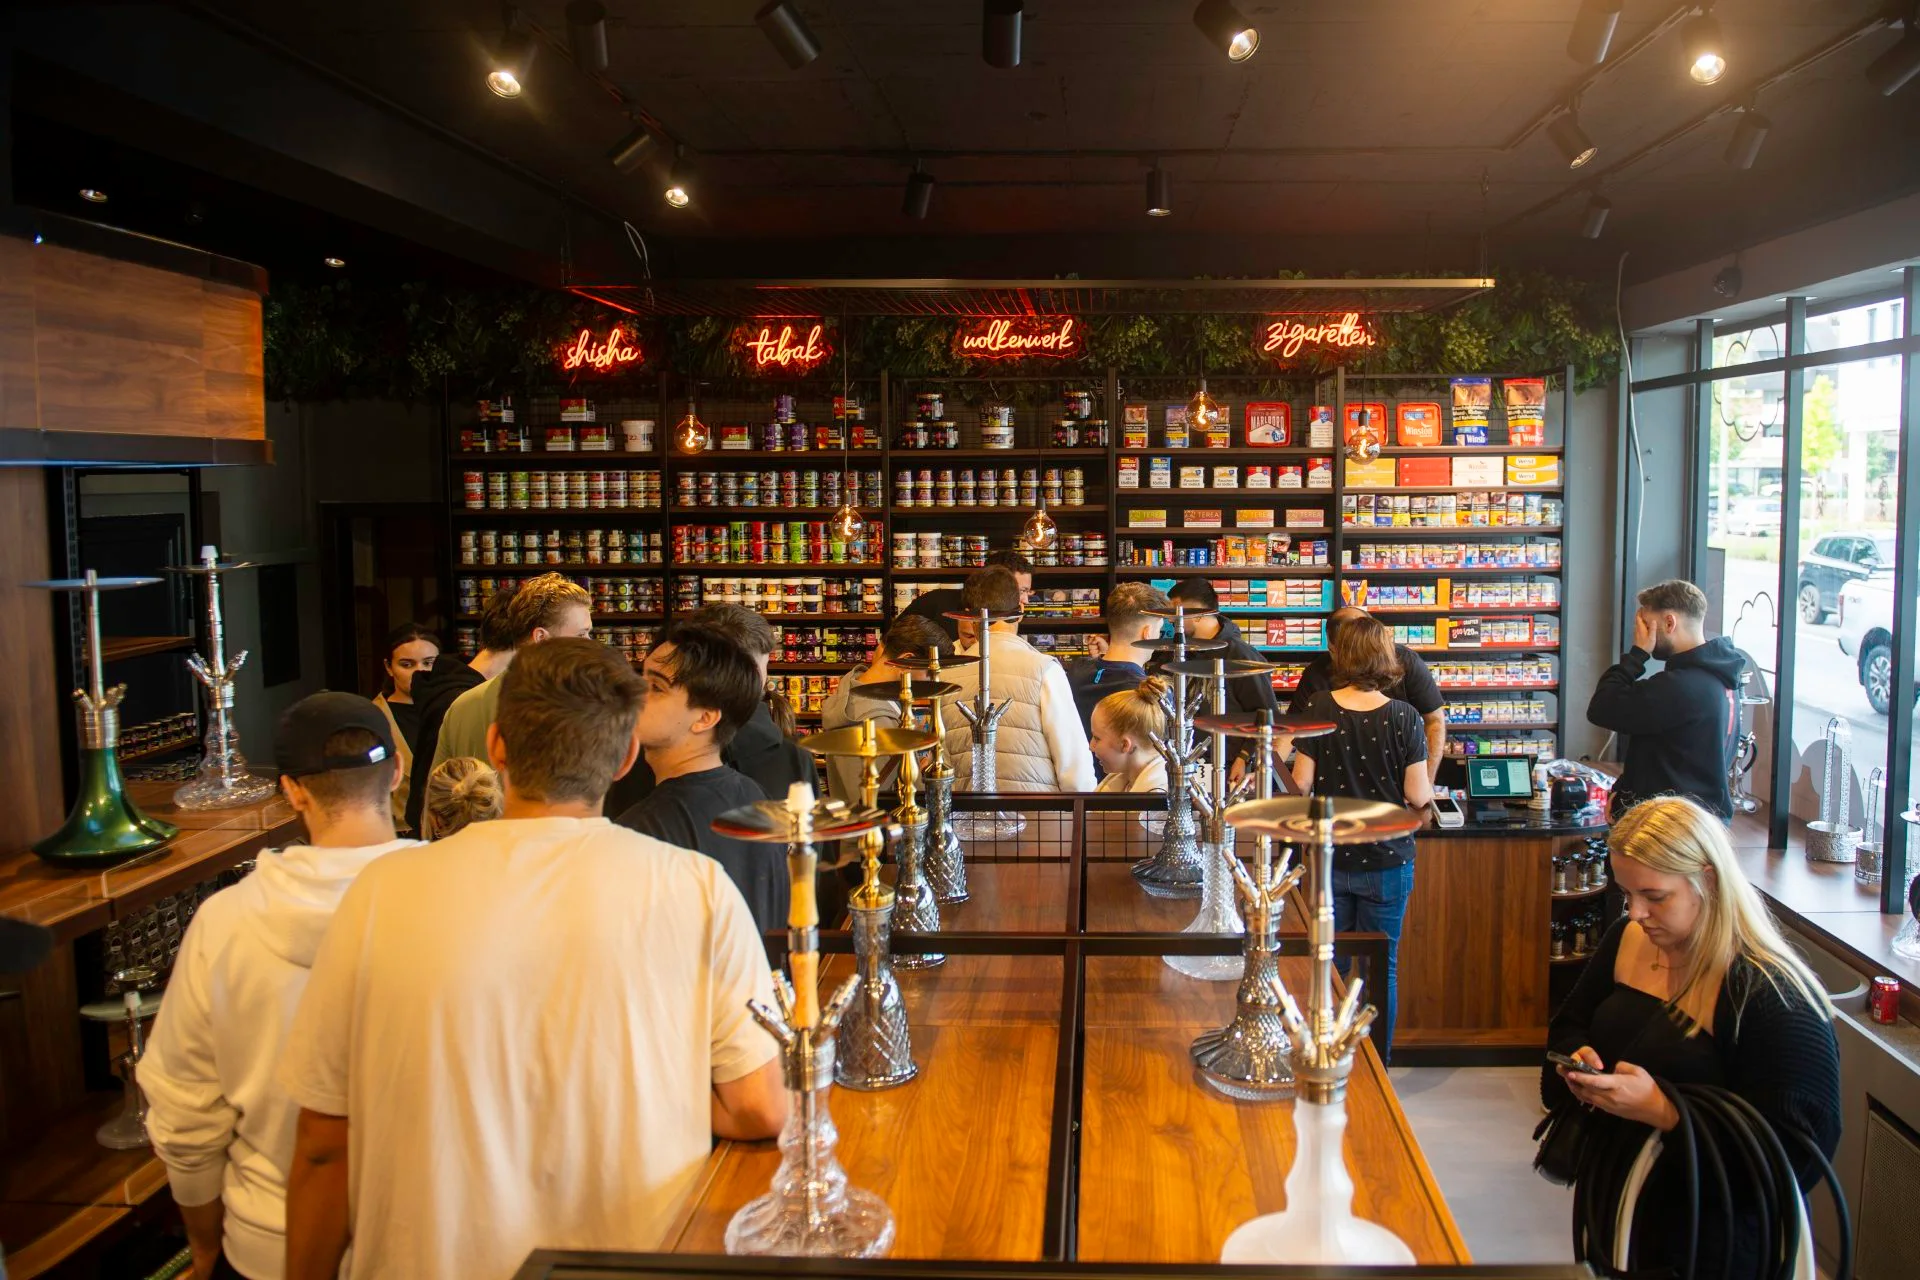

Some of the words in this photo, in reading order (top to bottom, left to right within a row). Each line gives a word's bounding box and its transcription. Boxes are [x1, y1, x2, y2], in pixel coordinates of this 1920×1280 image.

[564, 329, 638, 369] shisha
[747, 325, 824, 365] tabak
[963, 319, 1073, 351] wolkenwerk
[1263, 312, 1375, 358] zigaretten
[1250, 416, 1285, 431] MARLBORO
[1404, 426, 1433, 437] Winston
